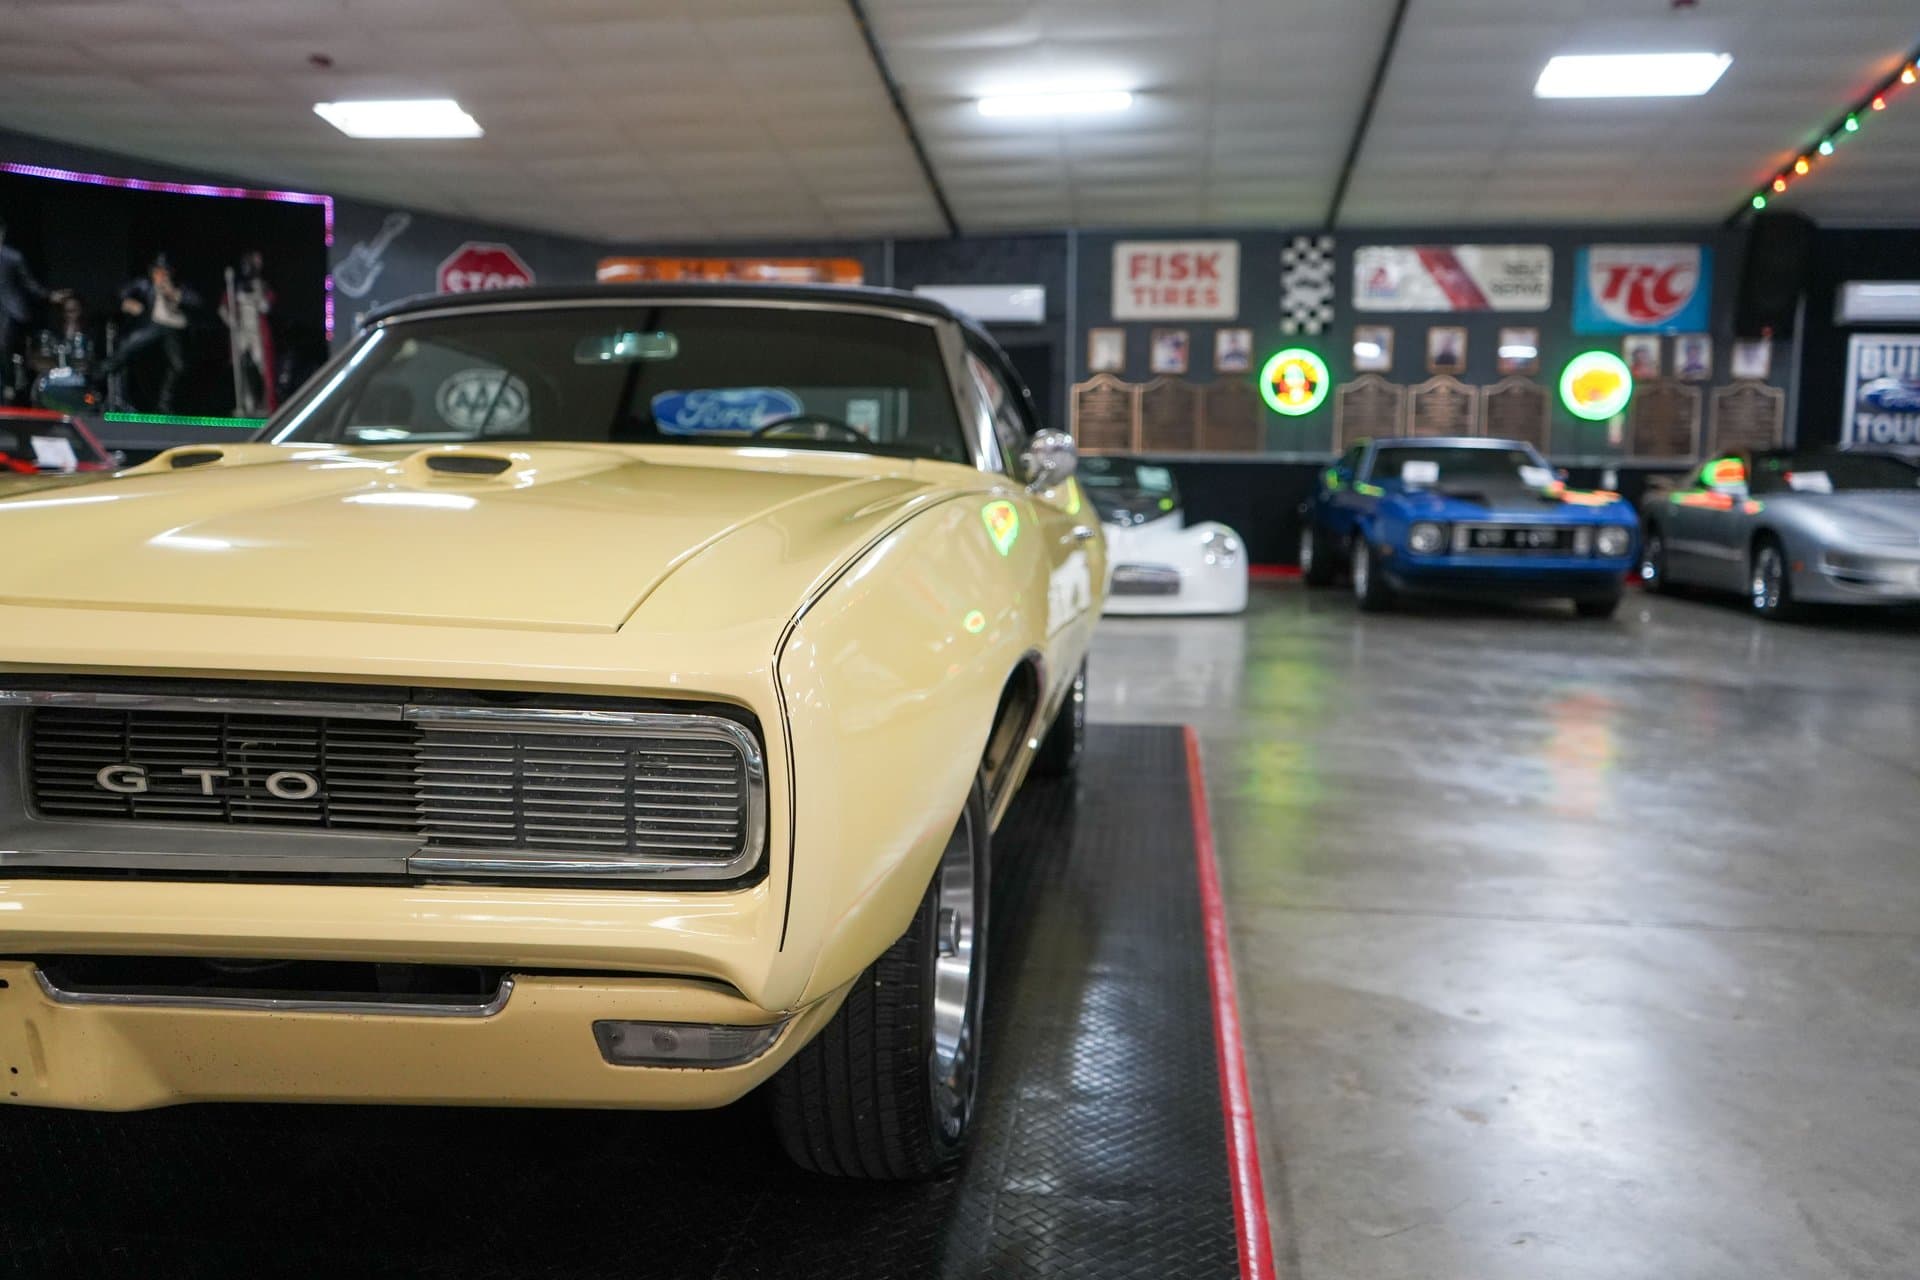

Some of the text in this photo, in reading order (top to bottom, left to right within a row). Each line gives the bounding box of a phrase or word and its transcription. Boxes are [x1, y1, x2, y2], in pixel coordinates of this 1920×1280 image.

[1129, 252, 1220, 281] FISK
[1132, 286, 1220, 308] TIRES
[1595, 263, 1696, 321] RC
[676, 389, 768, 427] Ford
[96, 765, 318, 800] GTO
